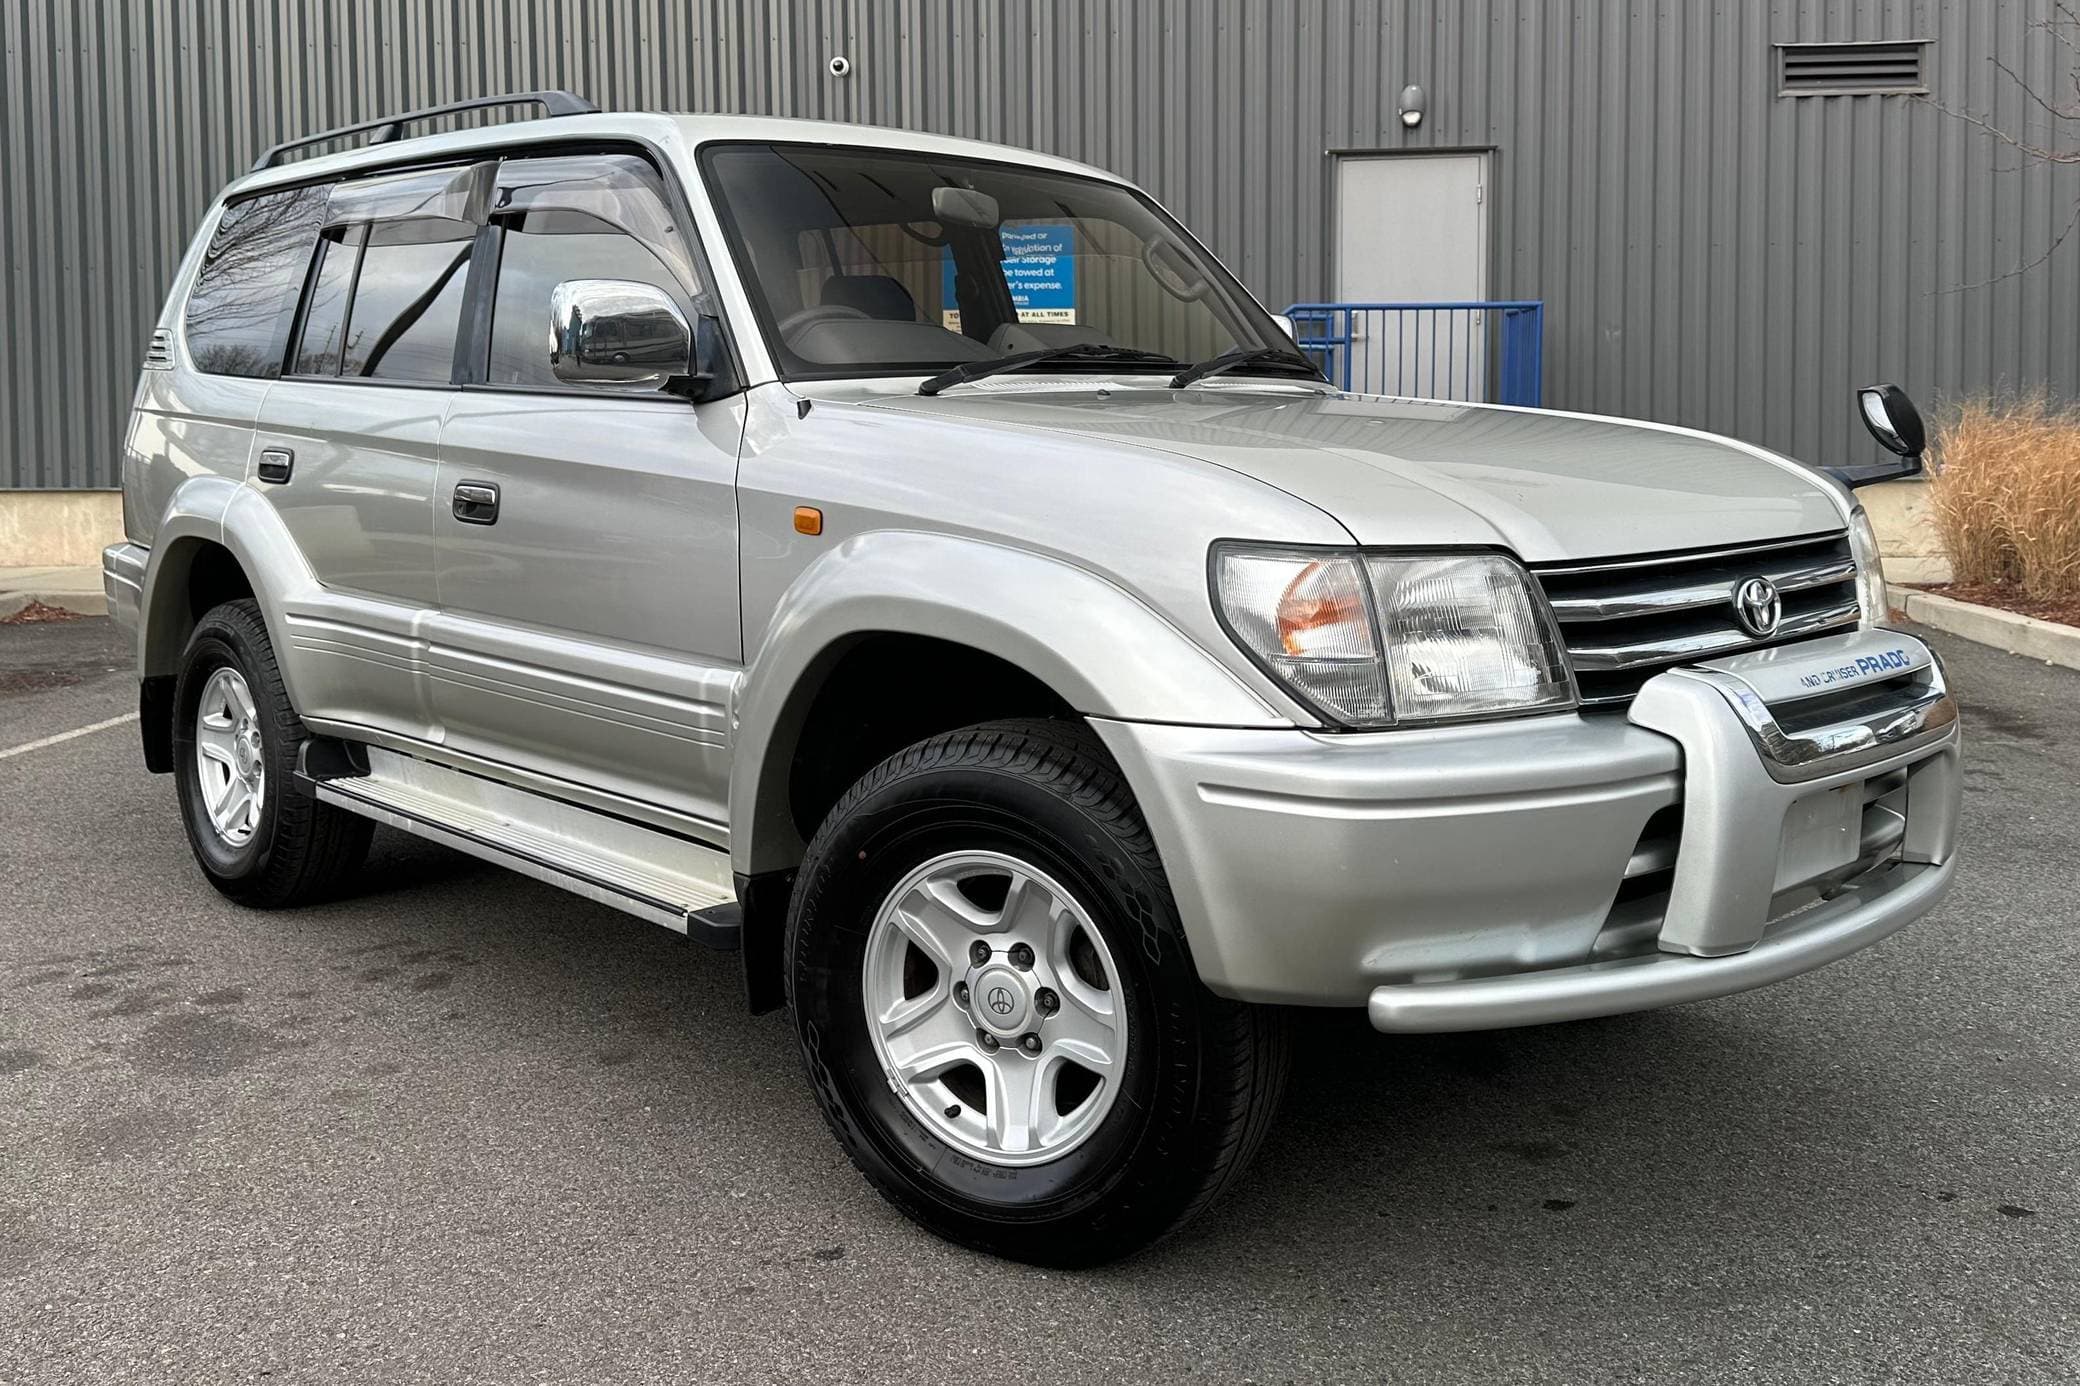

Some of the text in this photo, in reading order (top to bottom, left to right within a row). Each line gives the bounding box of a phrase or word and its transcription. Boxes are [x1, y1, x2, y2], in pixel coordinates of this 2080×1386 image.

[1053, 243, 1063, 252] of
[1014, 268, 1044, 277] towed
[1044, 268, 1055, 277] at
[1024, 281, 1062, 291] expense.
[1821, 666, 1860, 684] CRISER
